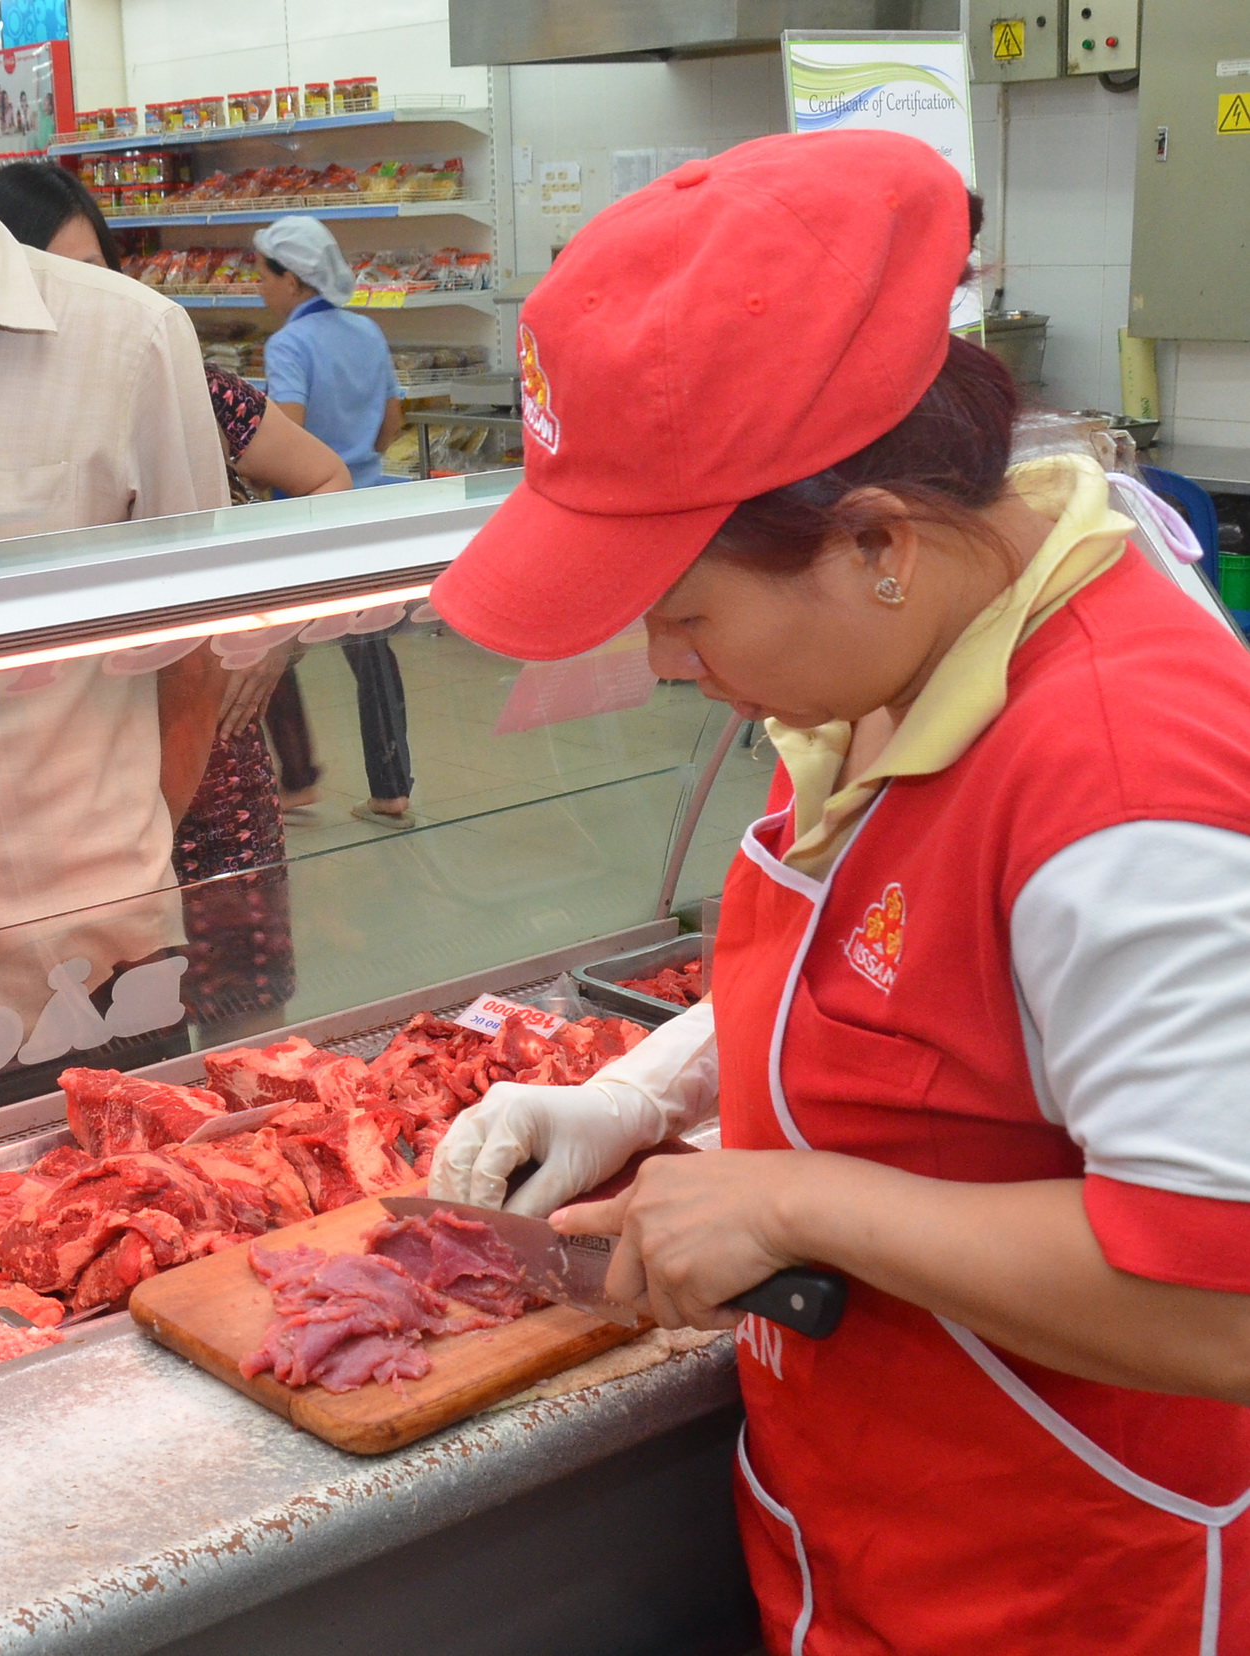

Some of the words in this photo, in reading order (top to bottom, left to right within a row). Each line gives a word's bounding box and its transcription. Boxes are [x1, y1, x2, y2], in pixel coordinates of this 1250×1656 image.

[809, 91, 869, 119] Certificate
[872, 90, 886, 118] of
[886, 90, 956, 117] Certification
